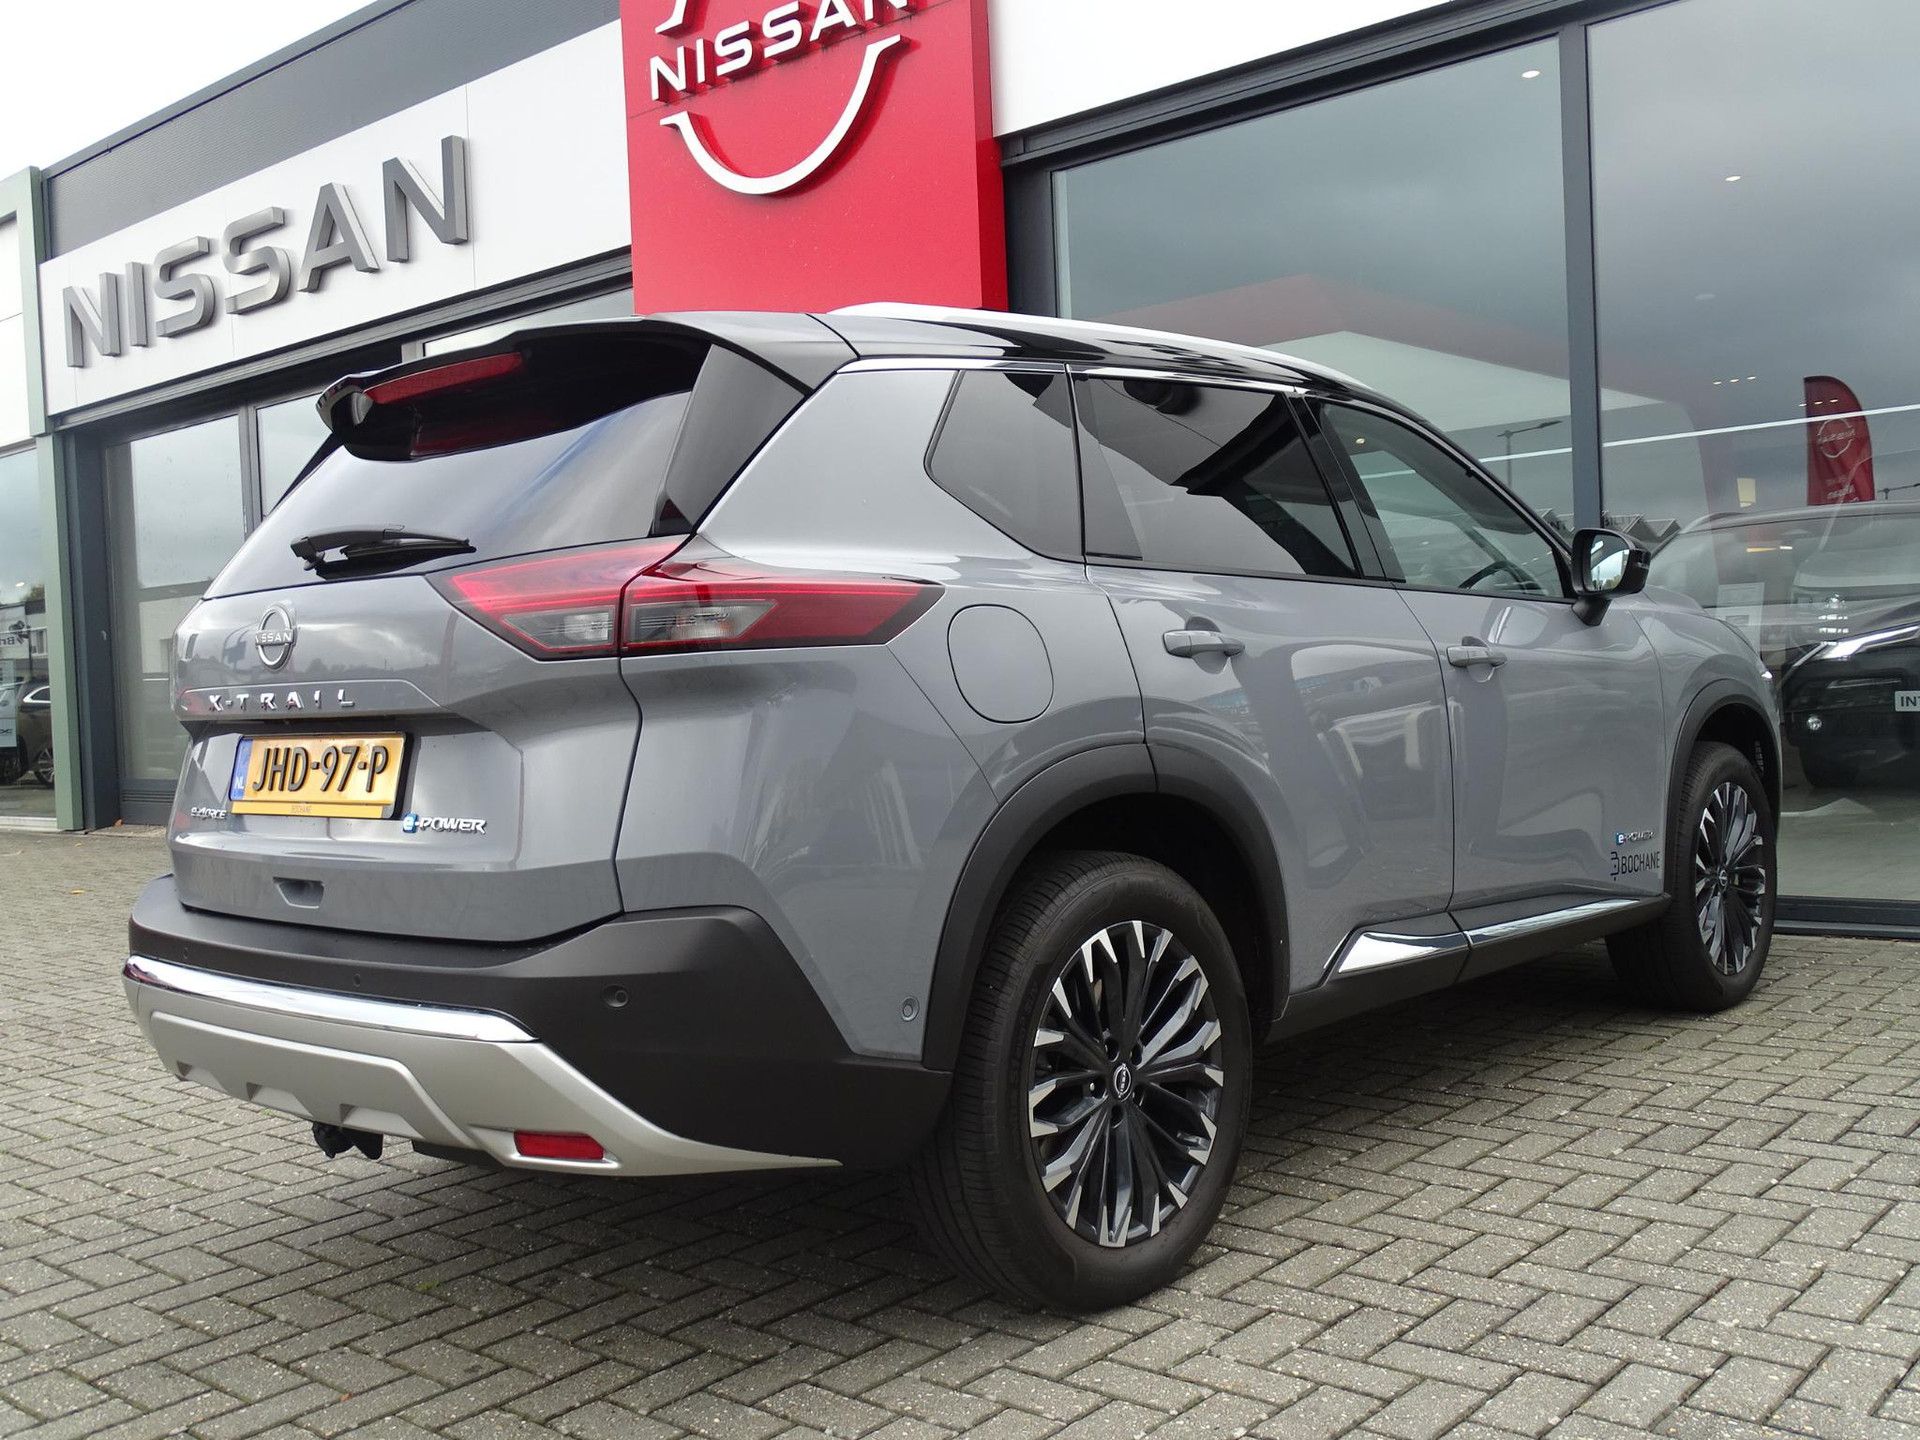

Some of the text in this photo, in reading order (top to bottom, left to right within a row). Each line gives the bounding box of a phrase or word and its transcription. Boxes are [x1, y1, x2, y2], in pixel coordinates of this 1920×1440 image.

[63, 135, 469, 368] NISSAN
[208, 689, 355, 712] X-TRAIL
[1900, 696, 1920, 707] IN
[252, 745, 389, 793] JHD-97-P
[402, 812, 487, 834] e-POWER
[1621, 851, 1661, 875] BOCHANE
